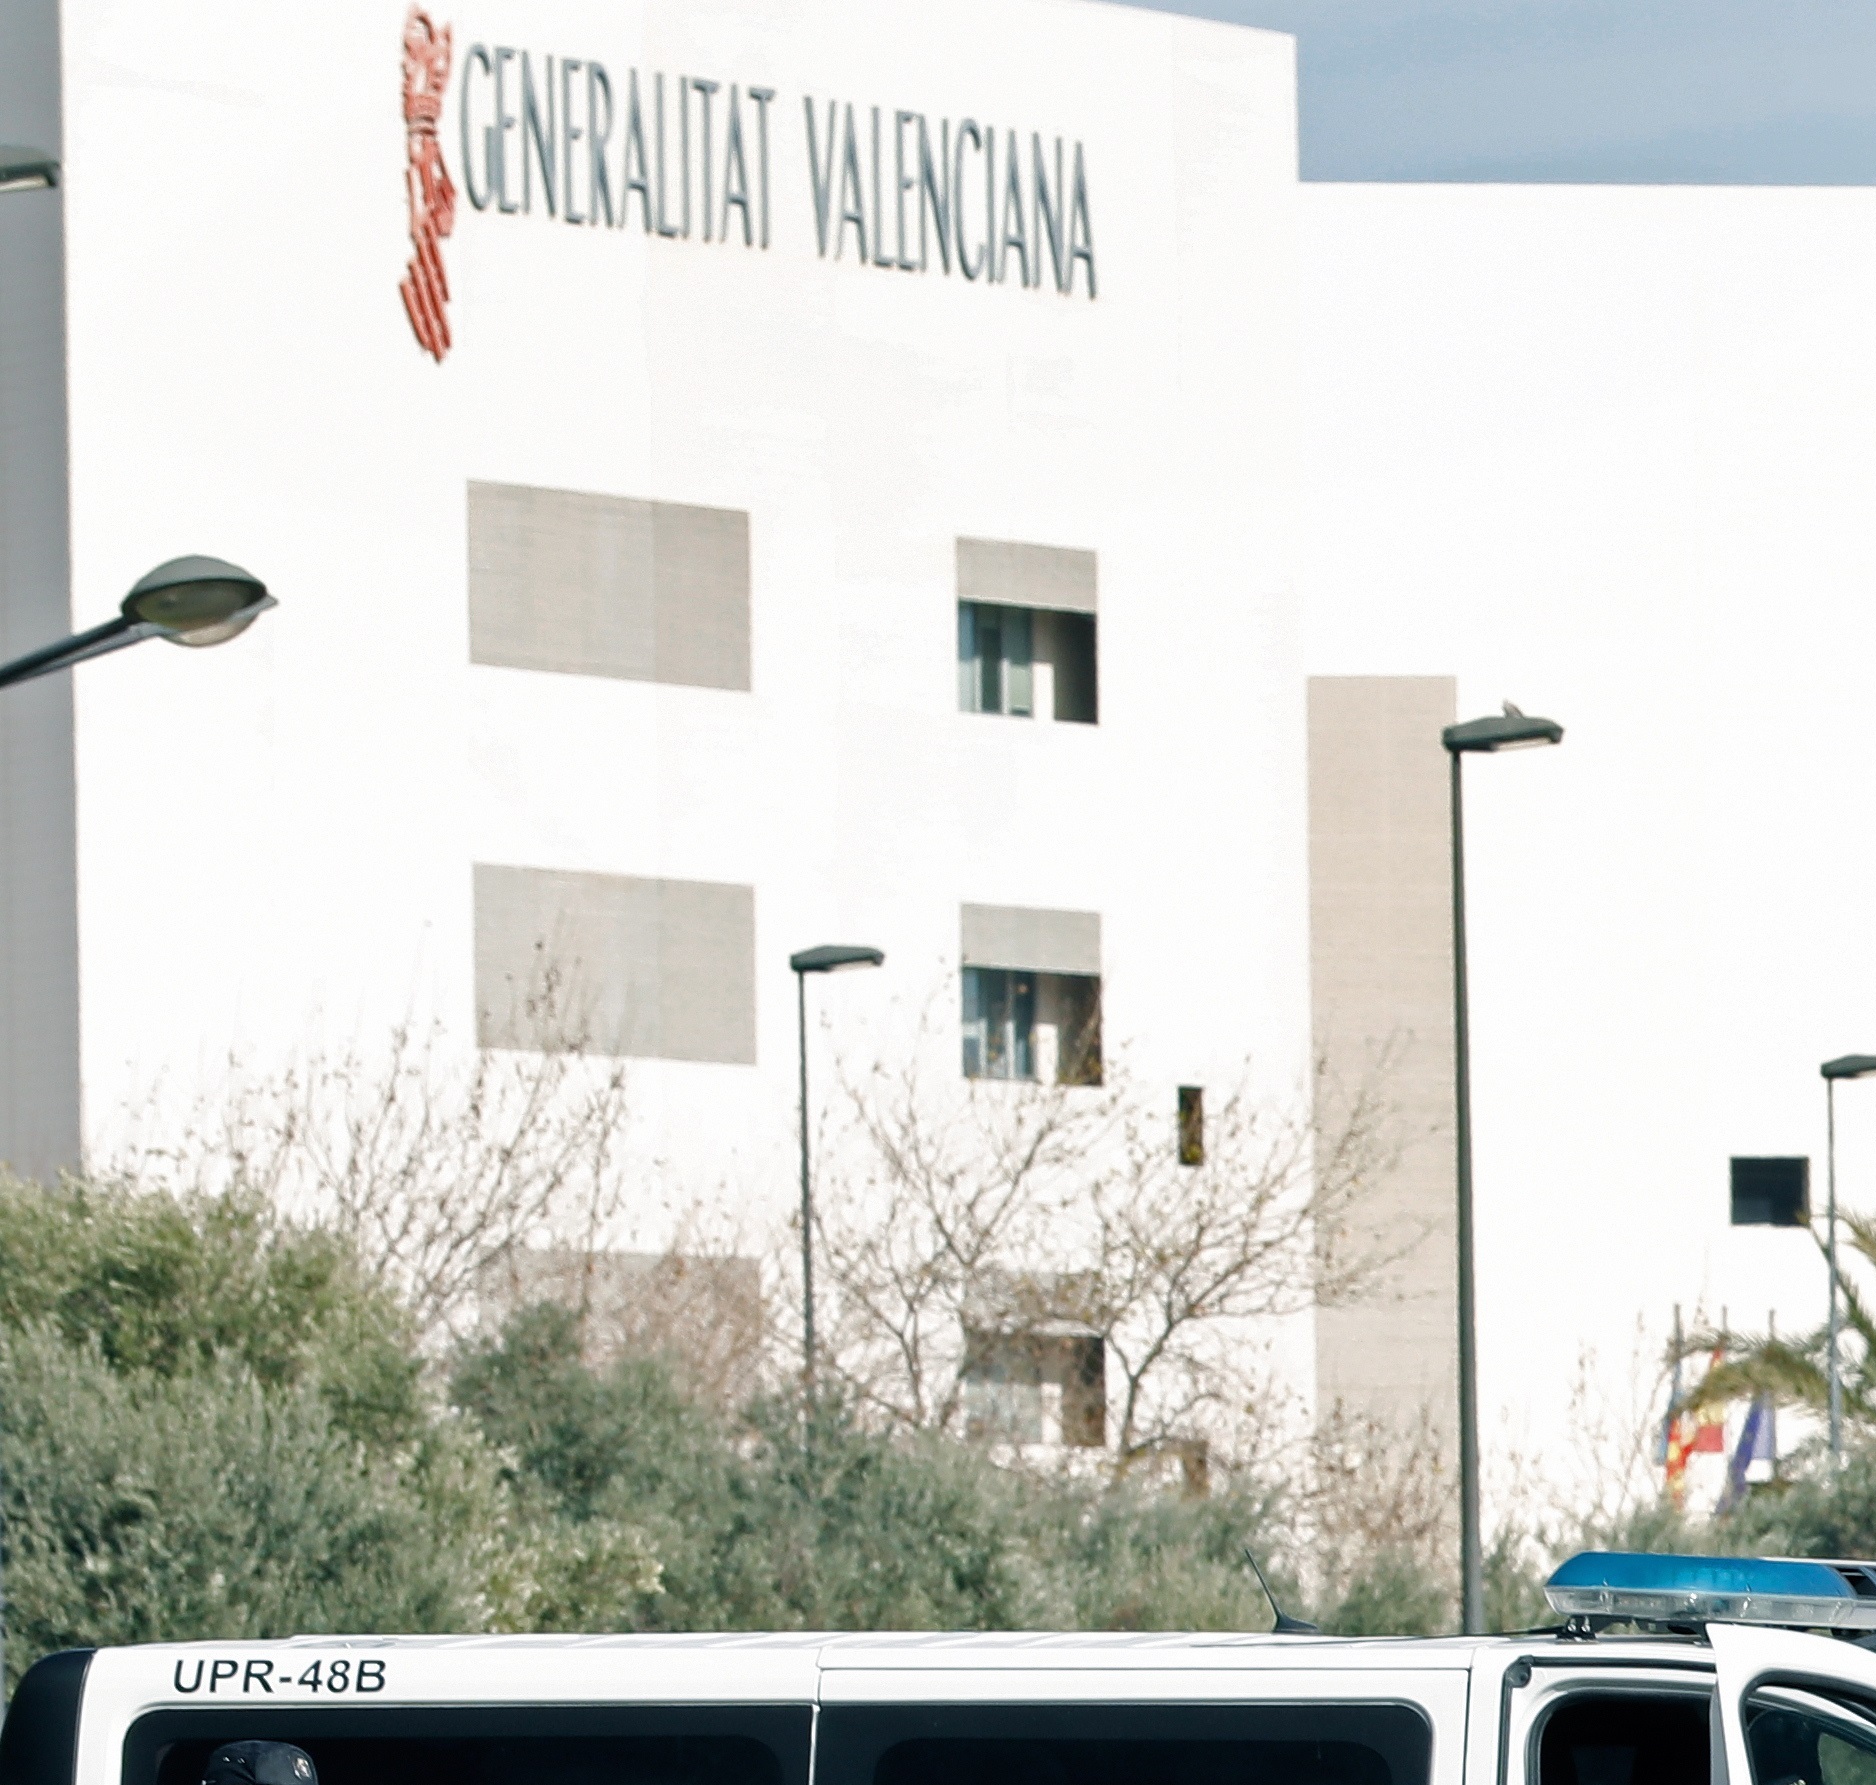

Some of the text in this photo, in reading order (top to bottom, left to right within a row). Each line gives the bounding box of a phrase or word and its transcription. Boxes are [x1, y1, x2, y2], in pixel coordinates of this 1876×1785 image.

[460, 42, 1097, 301] GENERALITAT VALENCIANA
[173, 1658, 386, 1694] UPR-48B
